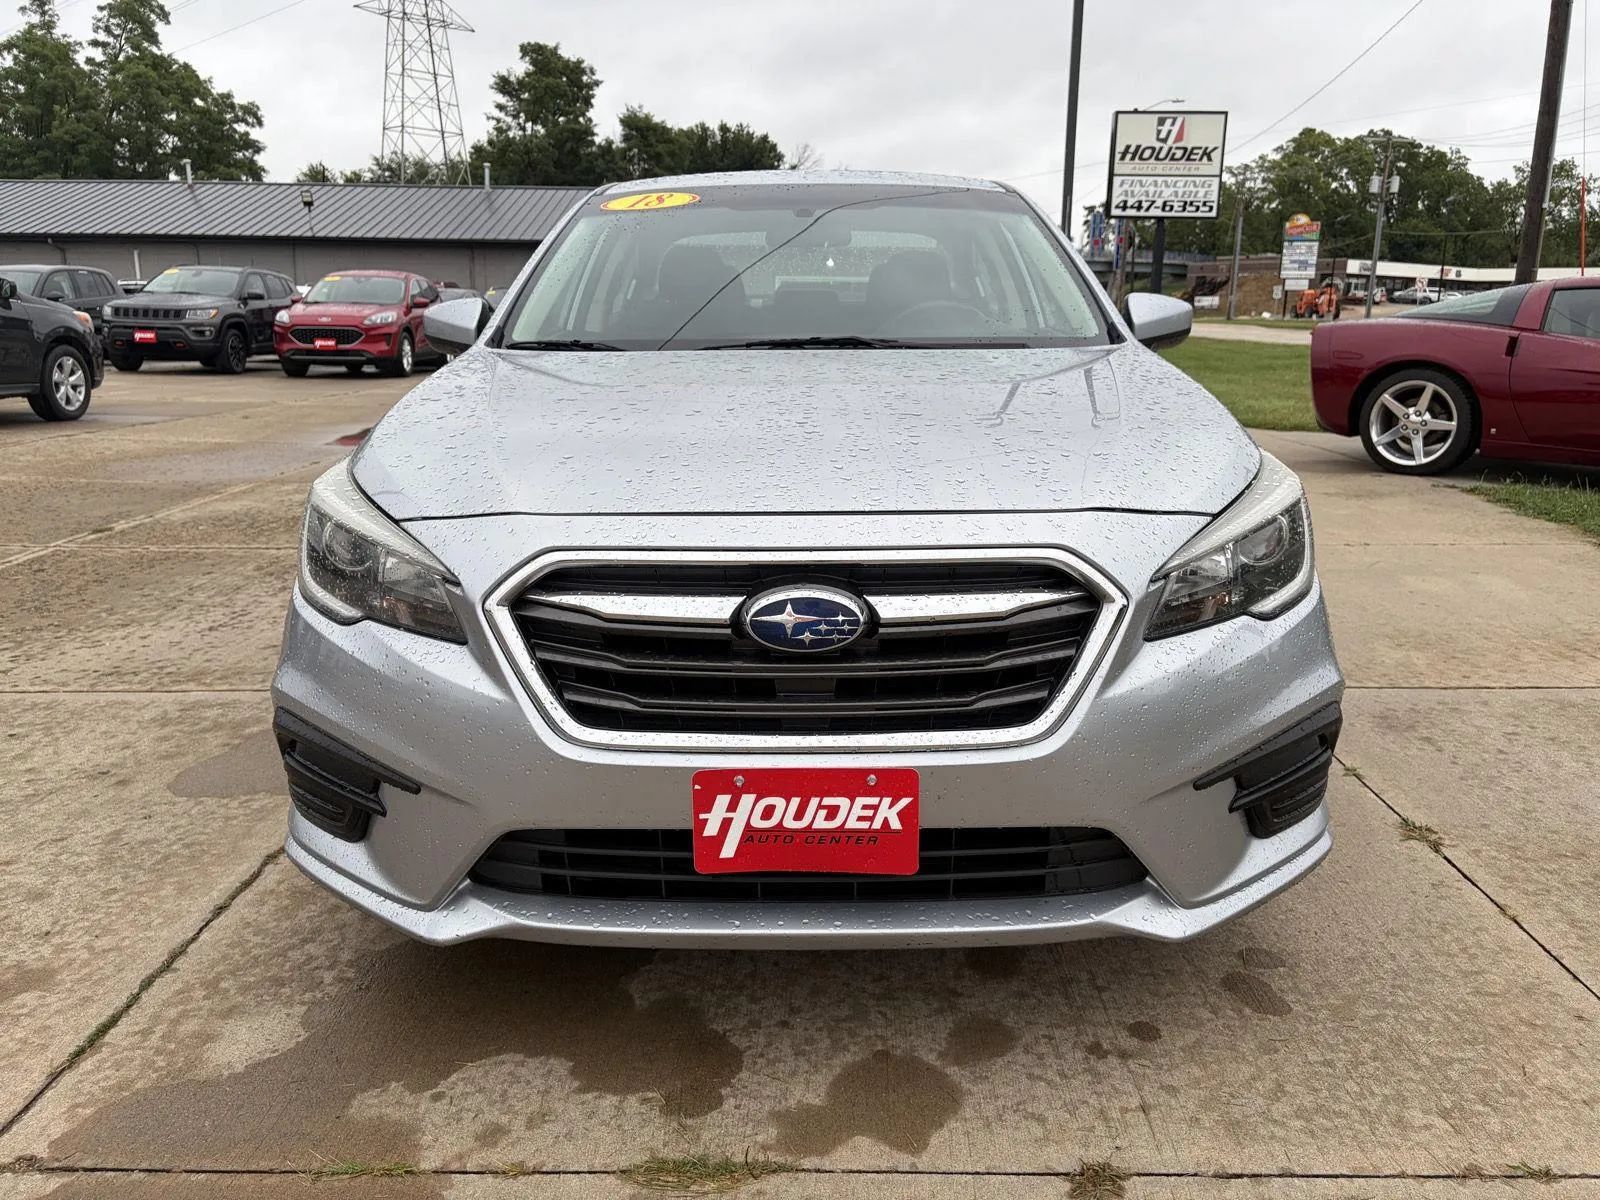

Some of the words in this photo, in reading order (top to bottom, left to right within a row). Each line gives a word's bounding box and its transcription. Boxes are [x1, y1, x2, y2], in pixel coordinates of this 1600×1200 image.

[1118, 144, 1219, 162] HOUDEK
[1118, 179, 1213, 189] FINANCING
[1117, 189, 1213, 199] AVAILABLE
[1114, 199, 1215, 213] 447-6355
[699, 793, 914, 859] HOUDEK
[744, 834, 794, 845] AUTO
[804, 835, 879, 846] CENTER
